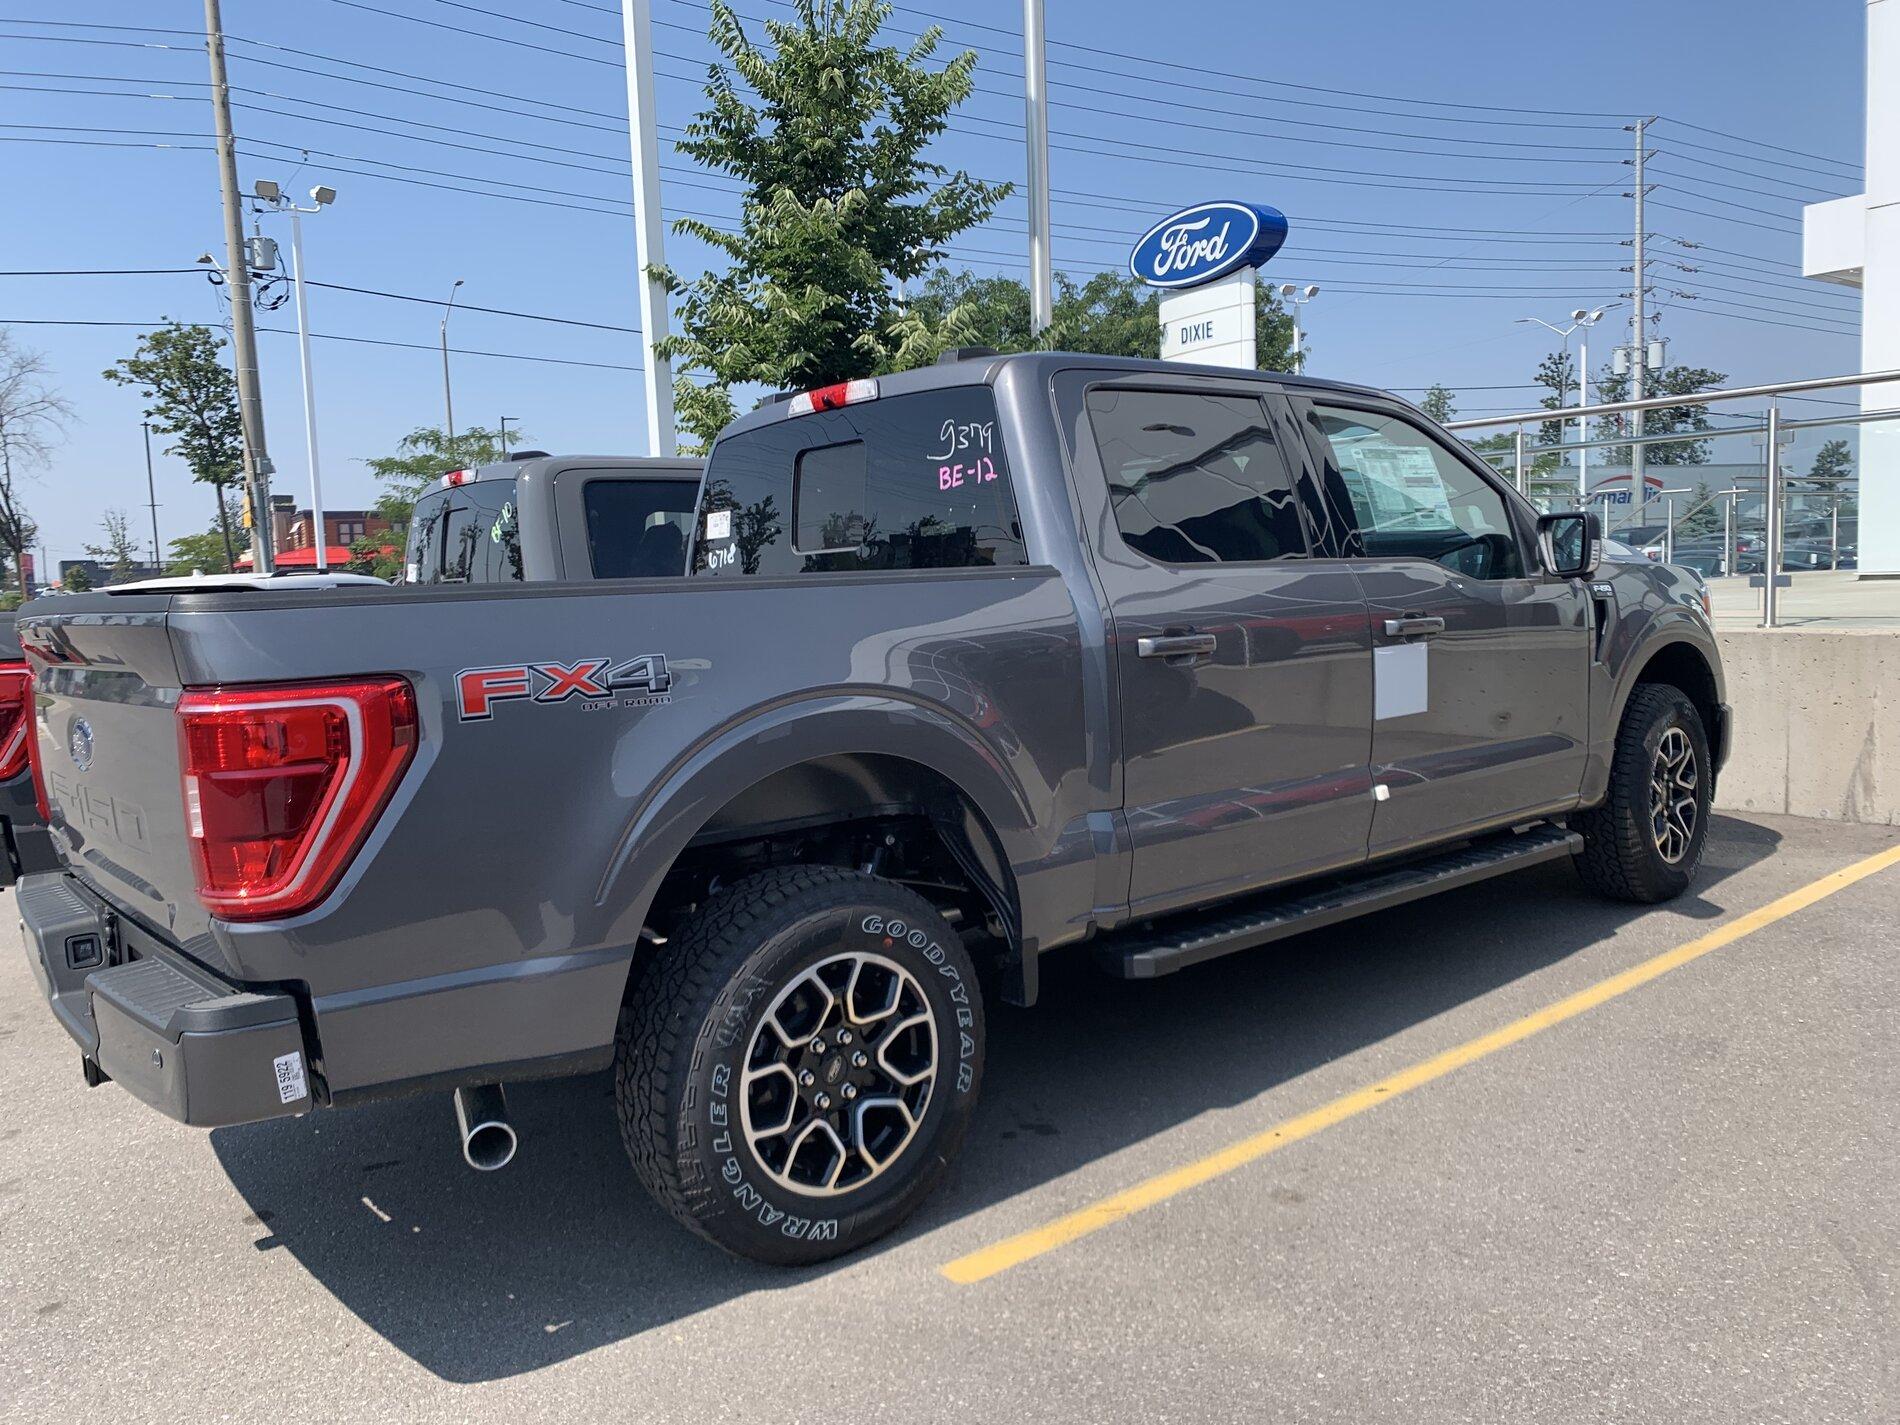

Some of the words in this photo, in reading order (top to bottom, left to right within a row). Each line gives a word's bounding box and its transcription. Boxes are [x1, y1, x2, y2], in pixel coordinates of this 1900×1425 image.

[1153, 216, 1231, 276] Ford
[1181, 321, 1214, 344] DIXIE
[939, 456, 998, 491] BE-12
[453, 653, 673, 723] FX4
[581, 700, 618, 712] OFF
[624, 696, 672, 708] ROAD
[861, 915, 975, 1096] GOODYEAR
[709, 1064, 838, 1241] WRANGLER
